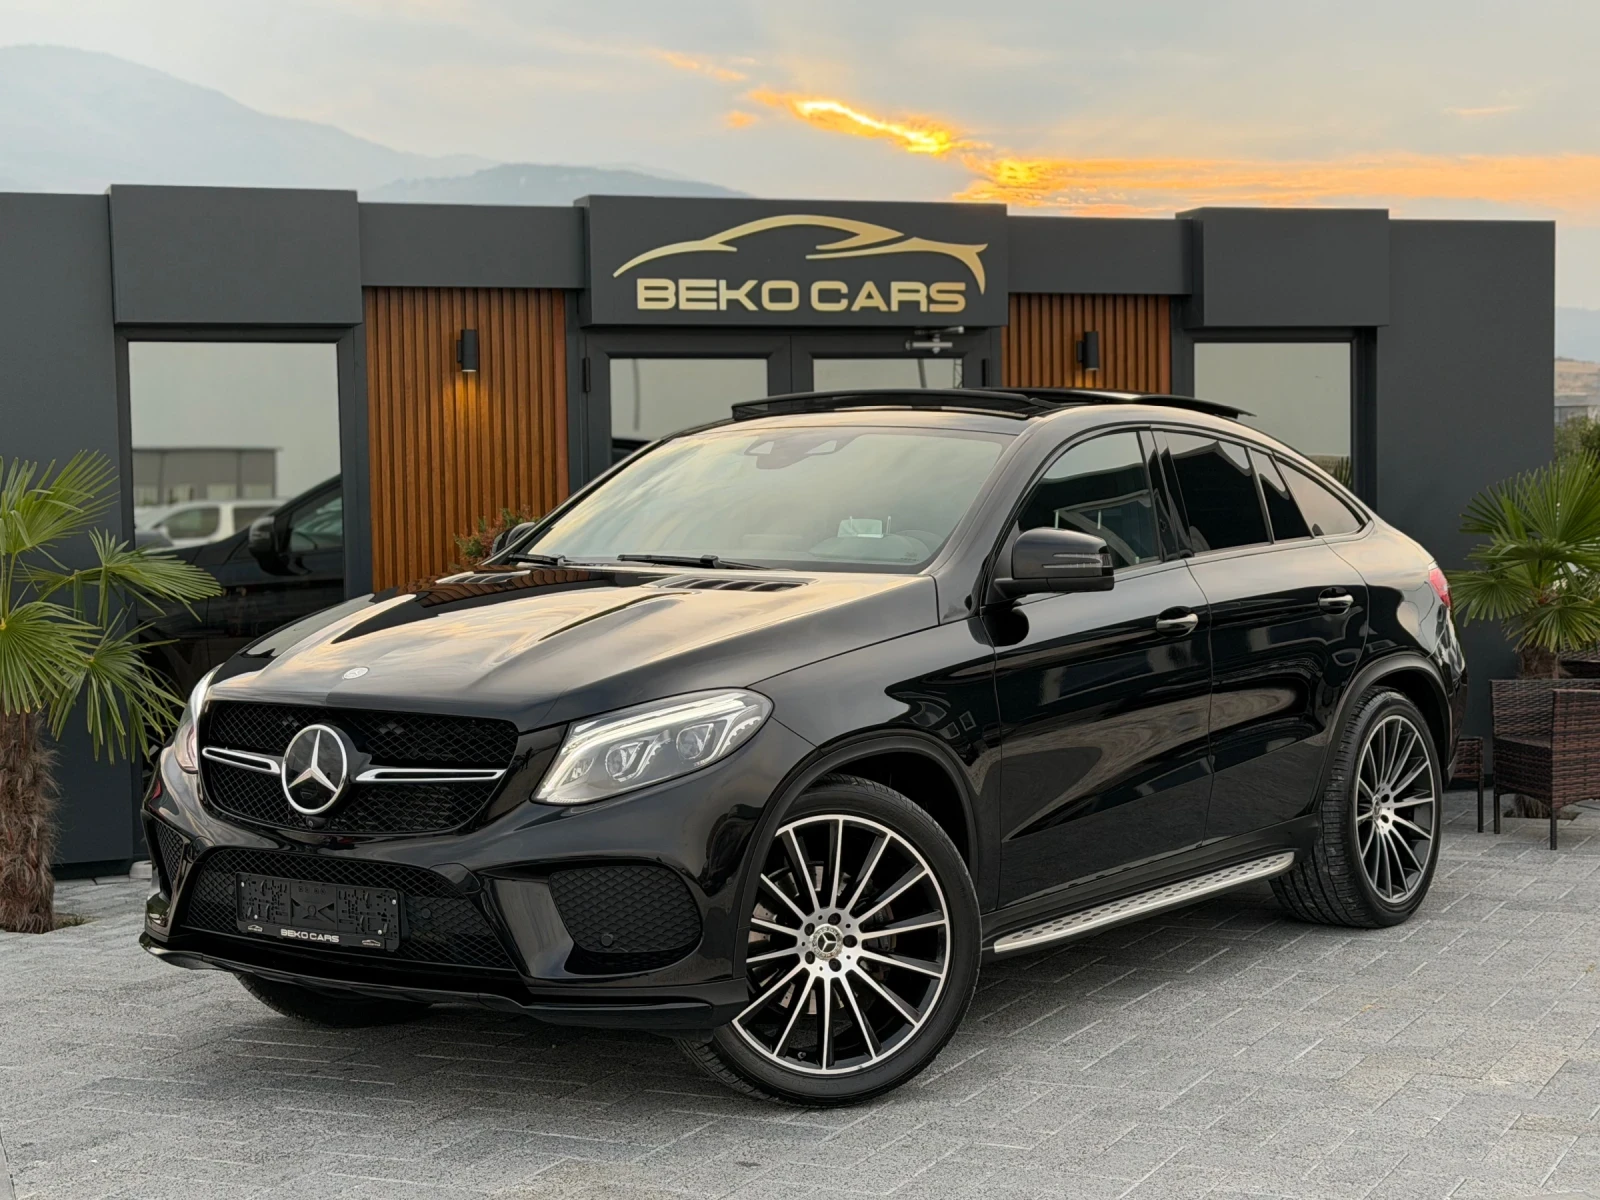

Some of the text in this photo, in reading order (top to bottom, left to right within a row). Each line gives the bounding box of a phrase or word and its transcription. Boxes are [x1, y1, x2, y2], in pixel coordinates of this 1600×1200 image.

[636, 278, 966, 313] BEKO CARS
[280, 928, 339, 943] BEKO CARS
